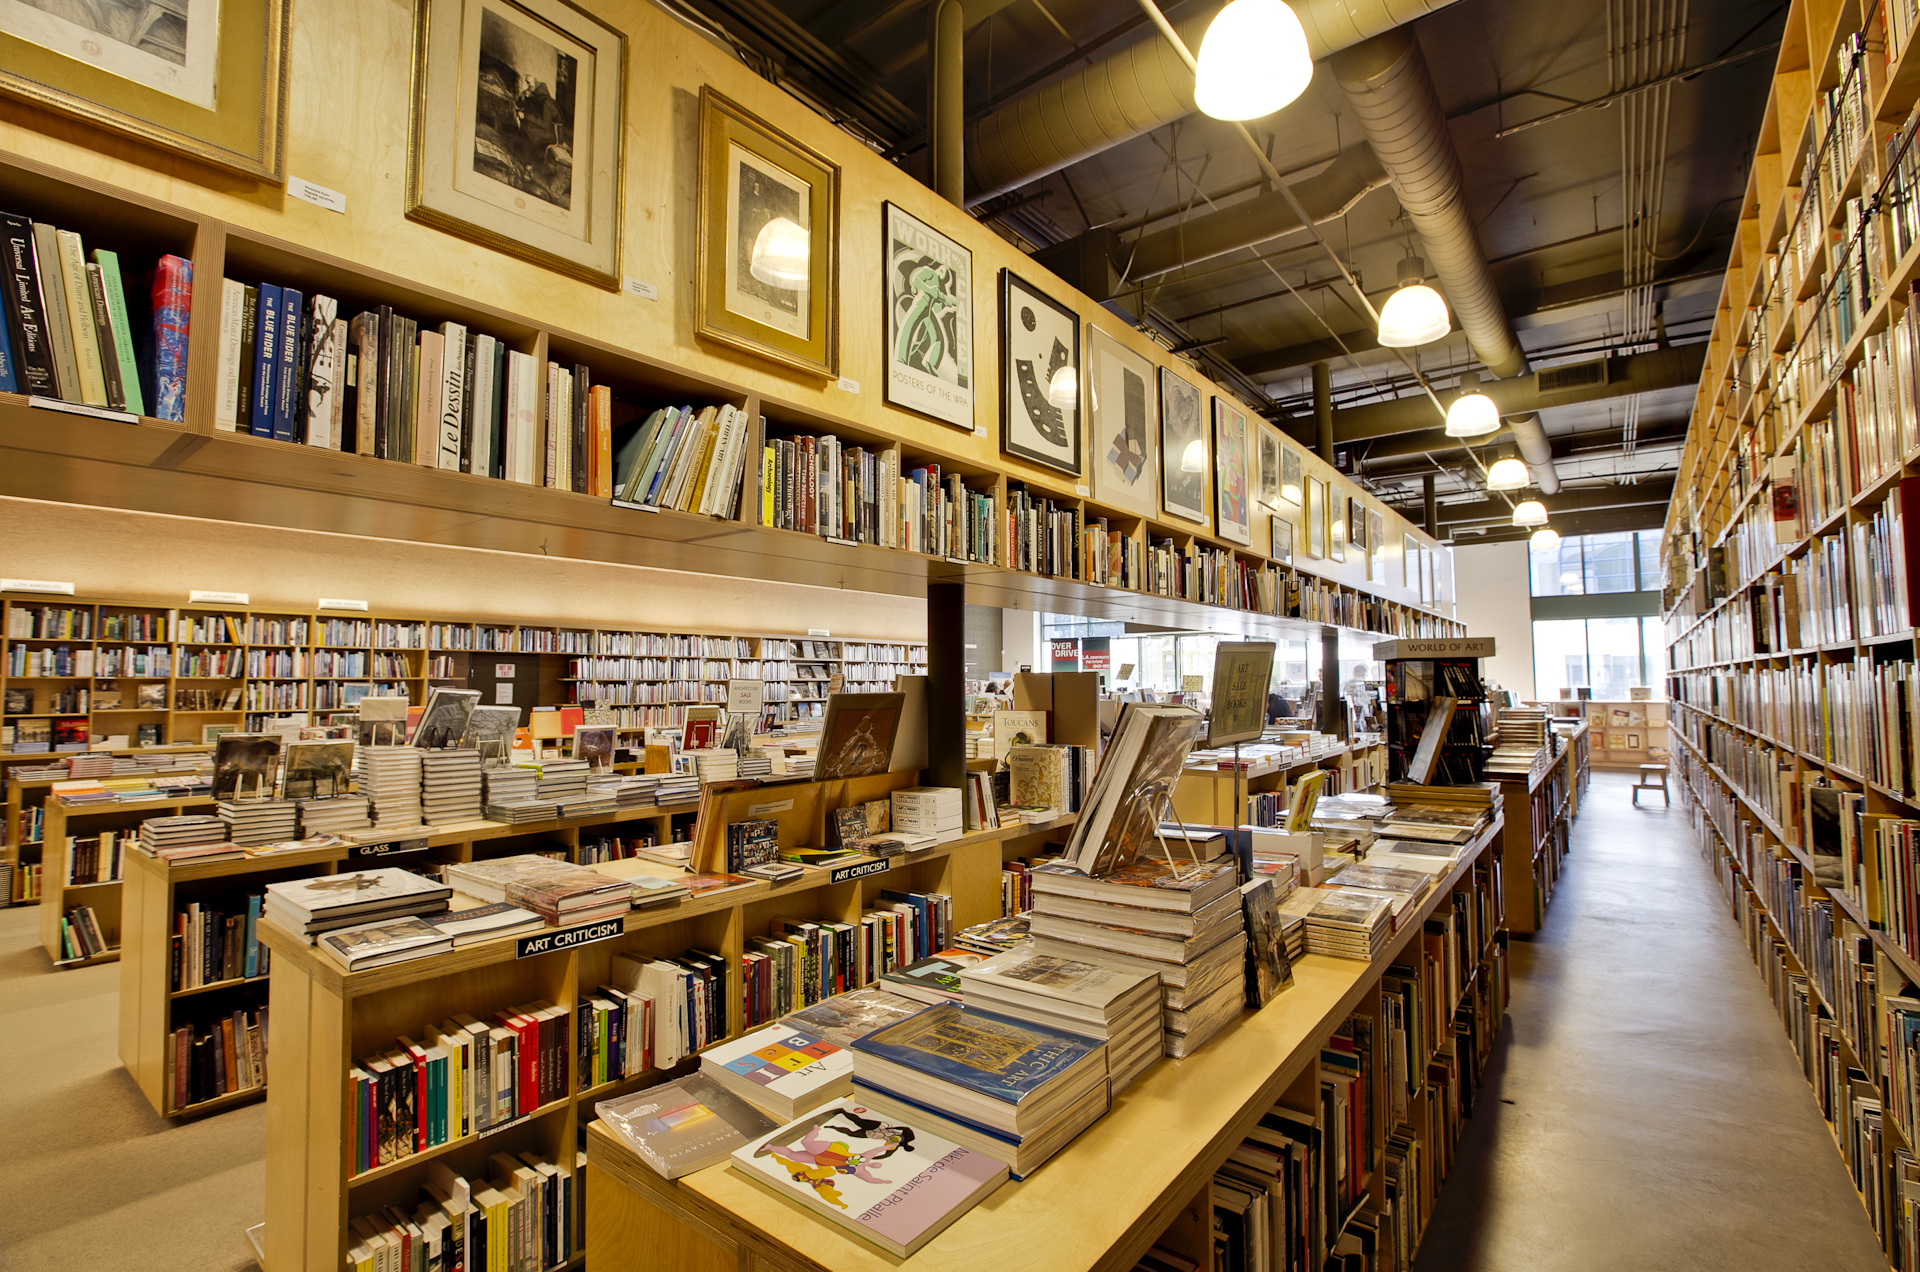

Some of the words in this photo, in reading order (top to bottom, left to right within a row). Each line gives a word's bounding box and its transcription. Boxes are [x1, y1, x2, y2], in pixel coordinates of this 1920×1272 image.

[68, 243, 77, 256] The
[895, 216, 950, 266] WORK
[10, 237, 26, 270] Universal
[69, 256, 78, 273] Age
[15, 274, 30, 303] Limited
[91, 271, 101, 298] American
[21, 305, 32, 320] Art
[78, 301, 86, 315] and
[95, 299, 106, 326] Drawings
[230, 288, 241, 316] American
[80, 313, 89, 339] Holbein
[229, 317, 239, 337] Master
[264, 308, 275, 331] BLUE
[285, 314, 295, 335] BLUE
[23, 322, 38, 352] Editions
[262, 332, 273, 358] RIDER
[336, 324, 346, 346] Creative
[226, 338, 239, 365] Drawings
[284, 336, 293, 362] RIDER
[334, 347, 343, 368] Copies
[228, 366, 237, 377] and
[464, 368, 473, 391] Drawings
[225, 378, 236, 411] Watercolors
[893, 370, 924, 391] POSTERS
[926, 382, 937, 395] OF
[939, 387, 951, 401] THE
[954, 394, 968, 407] WPA
[64, 404, 104, 415] DRAWINGS
[443, 371, 461, 430] Dessin
[721, 411, 734, 445] SCYTHIAN
[442, 432, 459, 457] Le
[699, 428, 711, 456] VENETIAN
[688, 456, 701, 488] DRAWINGS
[765, 459, 774, 494] Archaeology
[785, 473, 793, 520] Archaeology
[1408, 644, 1446, 652] WORLD
[1450, 643, 1462, 652] OF
[1466, 643, 1485, 651] ART
[1236, 664, 1249, 673] ART
[1232, 682, 1248, 691] SALE
[1227, 700, 1247, 710] BOOKS
[1002, 718, 1038, 727] TOUCANS
[360, 844, 389, 855] GLASS
[835, 868, 850, 882] ART
[850, 861, 887, 878] CRITICISM
[525, 939, 552, 954] ART
[554, 922, 617, 946] CRITICISM
[1029, 1038, 1081, 1070] GOTHIC
[795, 1062, 827, 1077] Art
[1001, 1068, 1030, 1087] ART
[716, 1129, 740, 1142] DAN
[669, 1141, 712, 1158] FLAVIN
[944, 1147, 970, 1165] Niki
[927, 1162, 945, 1174] de
[900, 1172, 932, 1196] Saint
[859, 1193, 903, 1221] Phalle
[454, 1215, 463, 1261] SHADES
